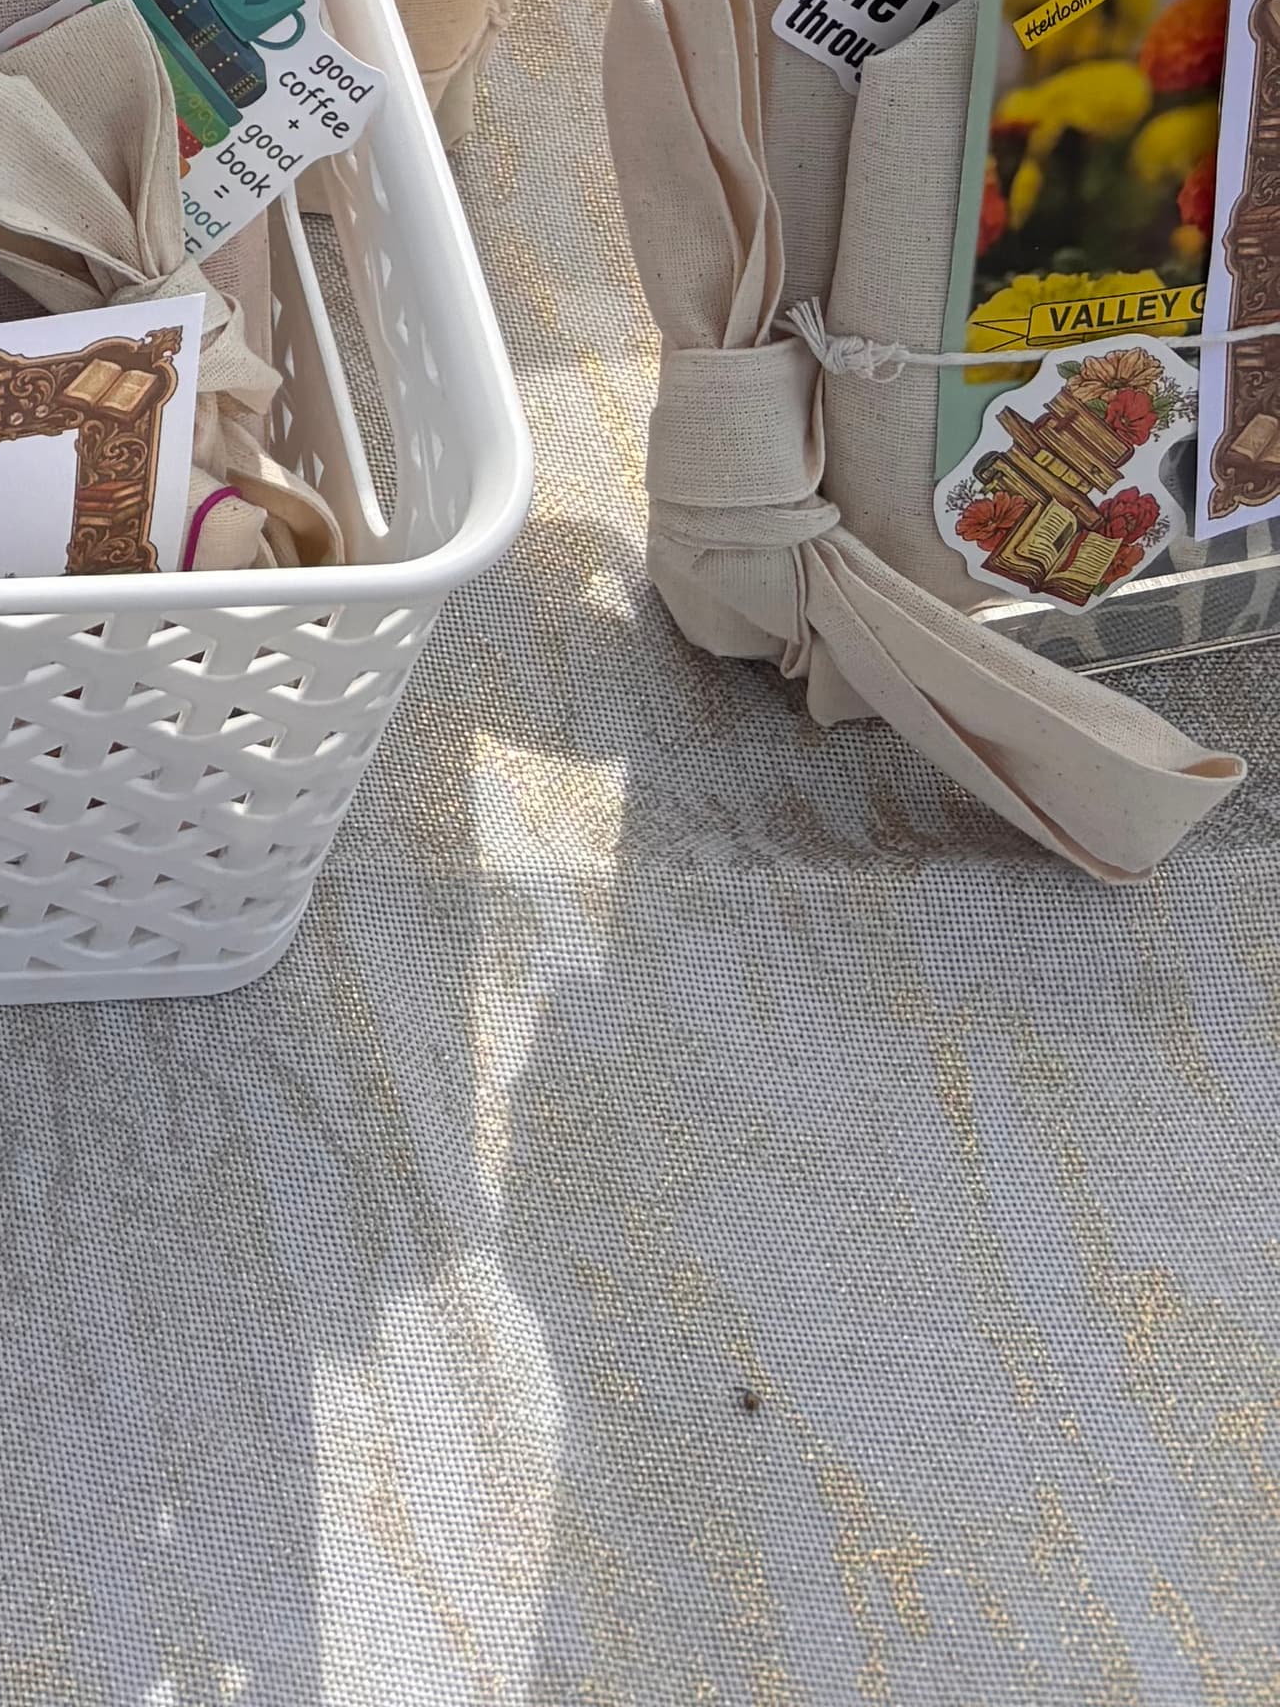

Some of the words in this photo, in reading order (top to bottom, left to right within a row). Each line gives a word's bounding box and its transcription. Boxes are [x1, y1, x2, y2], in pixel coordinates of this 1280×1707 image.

[308, 54, 375, 104] good
[278, 70, 351, 139] coffee
[216, 143, 272, 199] book
[238, 123, 304, 172] good
[1048, 290, 1179, 333] VALLEY
